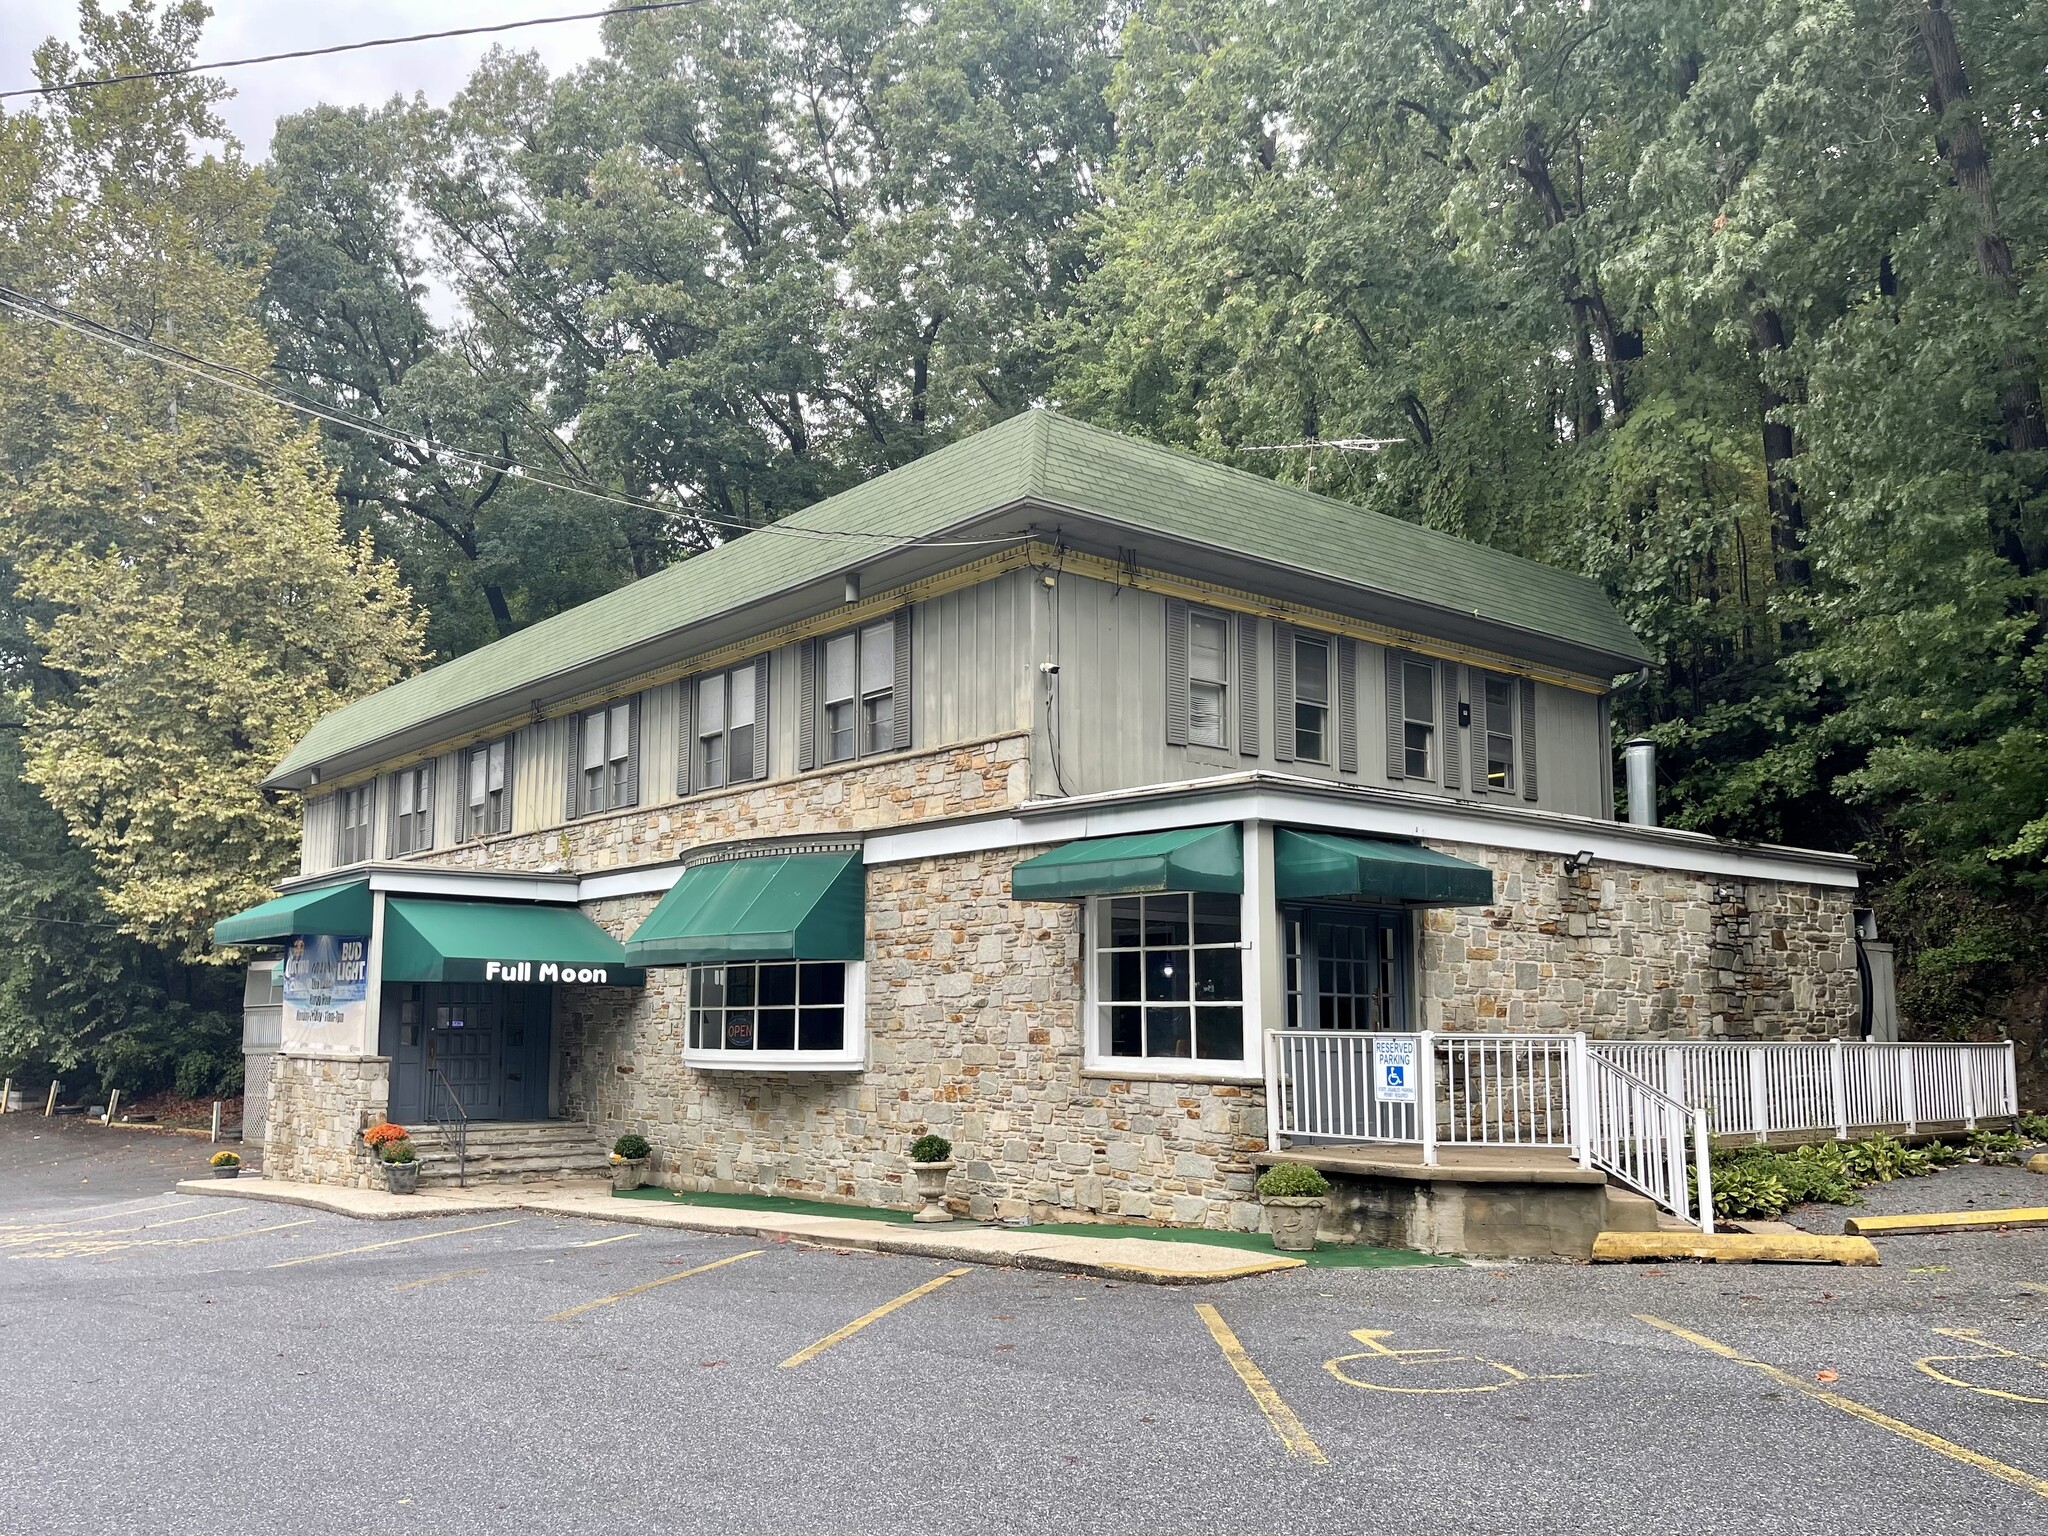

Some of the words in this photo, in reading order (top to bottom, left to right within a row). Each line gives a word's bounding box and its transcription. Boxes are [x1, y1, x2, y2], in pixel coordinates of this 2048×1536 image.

[342, 942, 362, 961] BUD
[336, 961, 366, 981] LIGHT
[485, 961, 532, 982] Full
[538, 963, 608, 984] Moon
[728, 1025, 752, 1038] OPEN
[1376, 1042, 1413, 1054] RESERVED
[1379, 1053, 1411, 1066] PARKING
